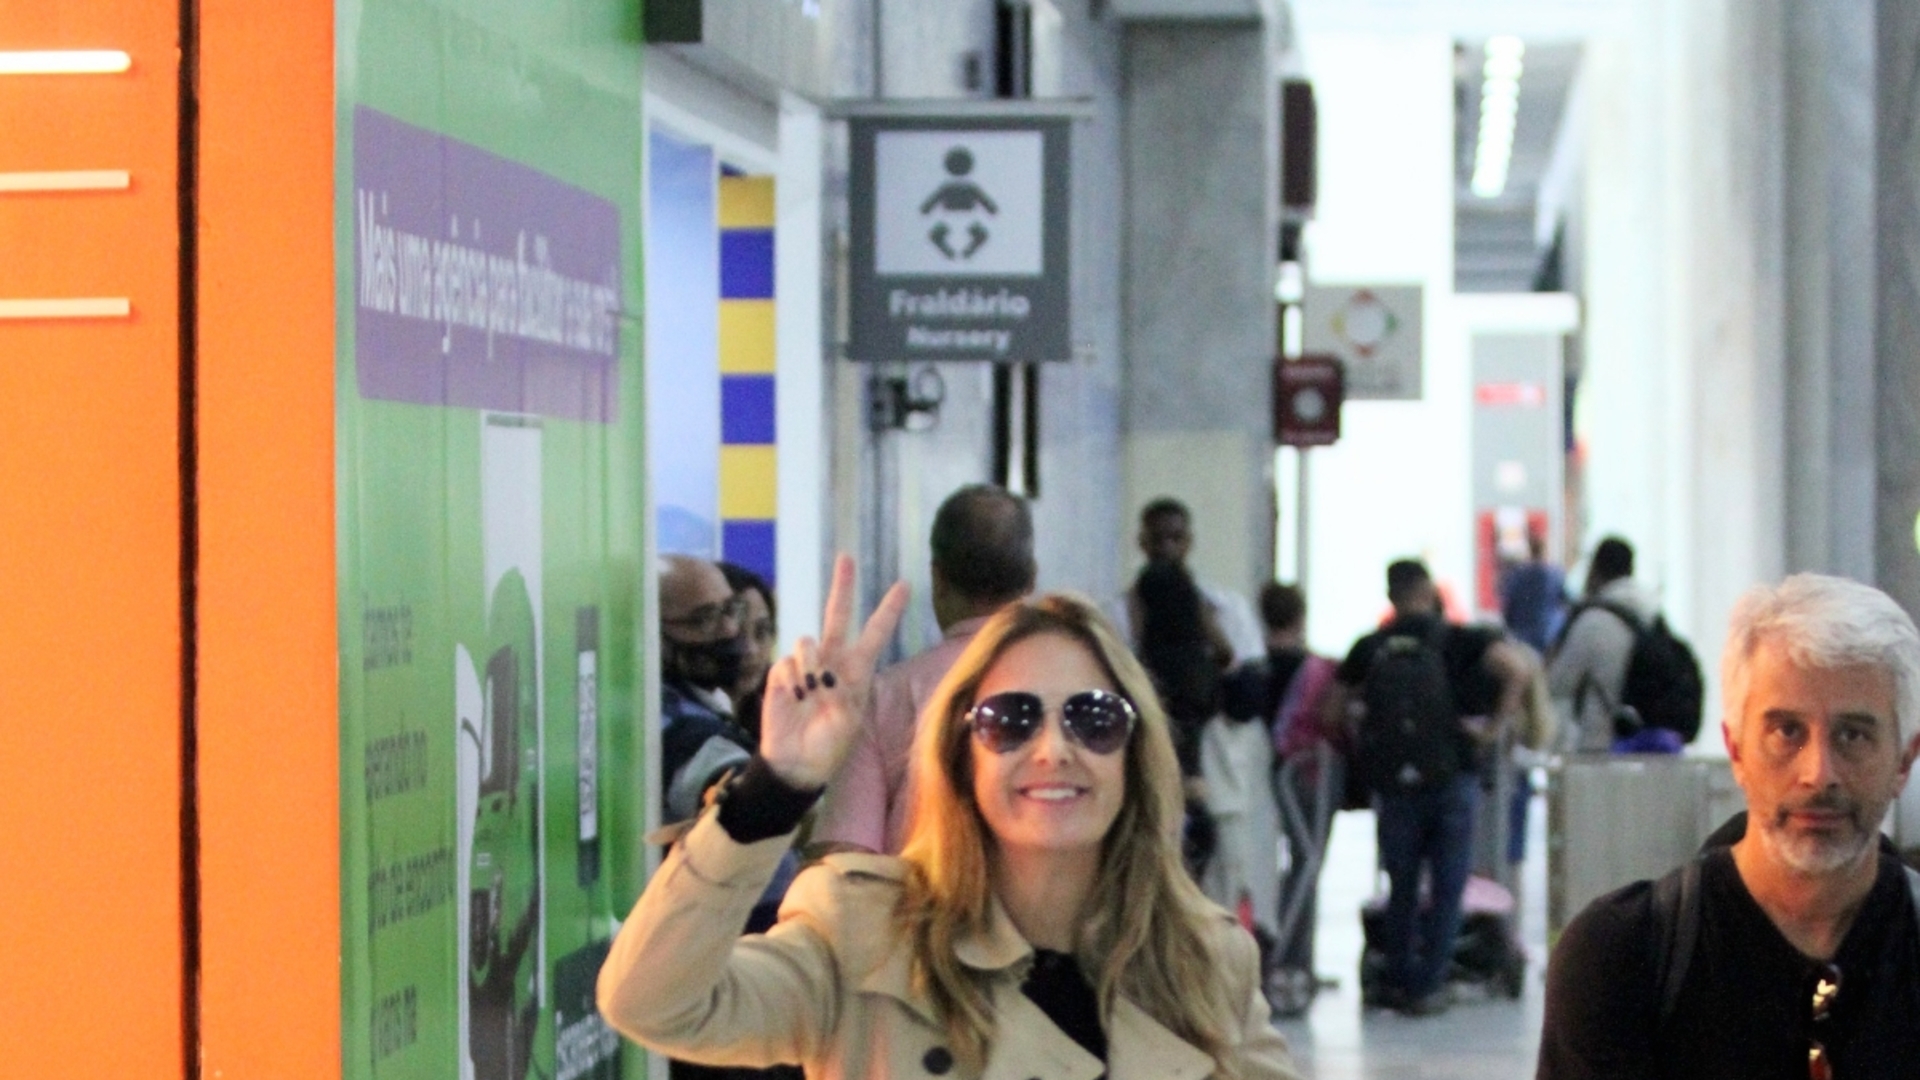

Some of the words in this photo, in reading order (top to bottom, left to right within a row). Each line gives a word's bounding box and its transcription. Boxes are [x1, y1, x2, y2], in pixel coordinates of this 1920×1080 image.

[358, 188, 396, 313] Mais
[397, 229, 430, 320] uma
[433, 213, 486, 354] agência
[888, 287, 1031, 316] Fraldário
[907, 326, 1011, 353] Nursery
